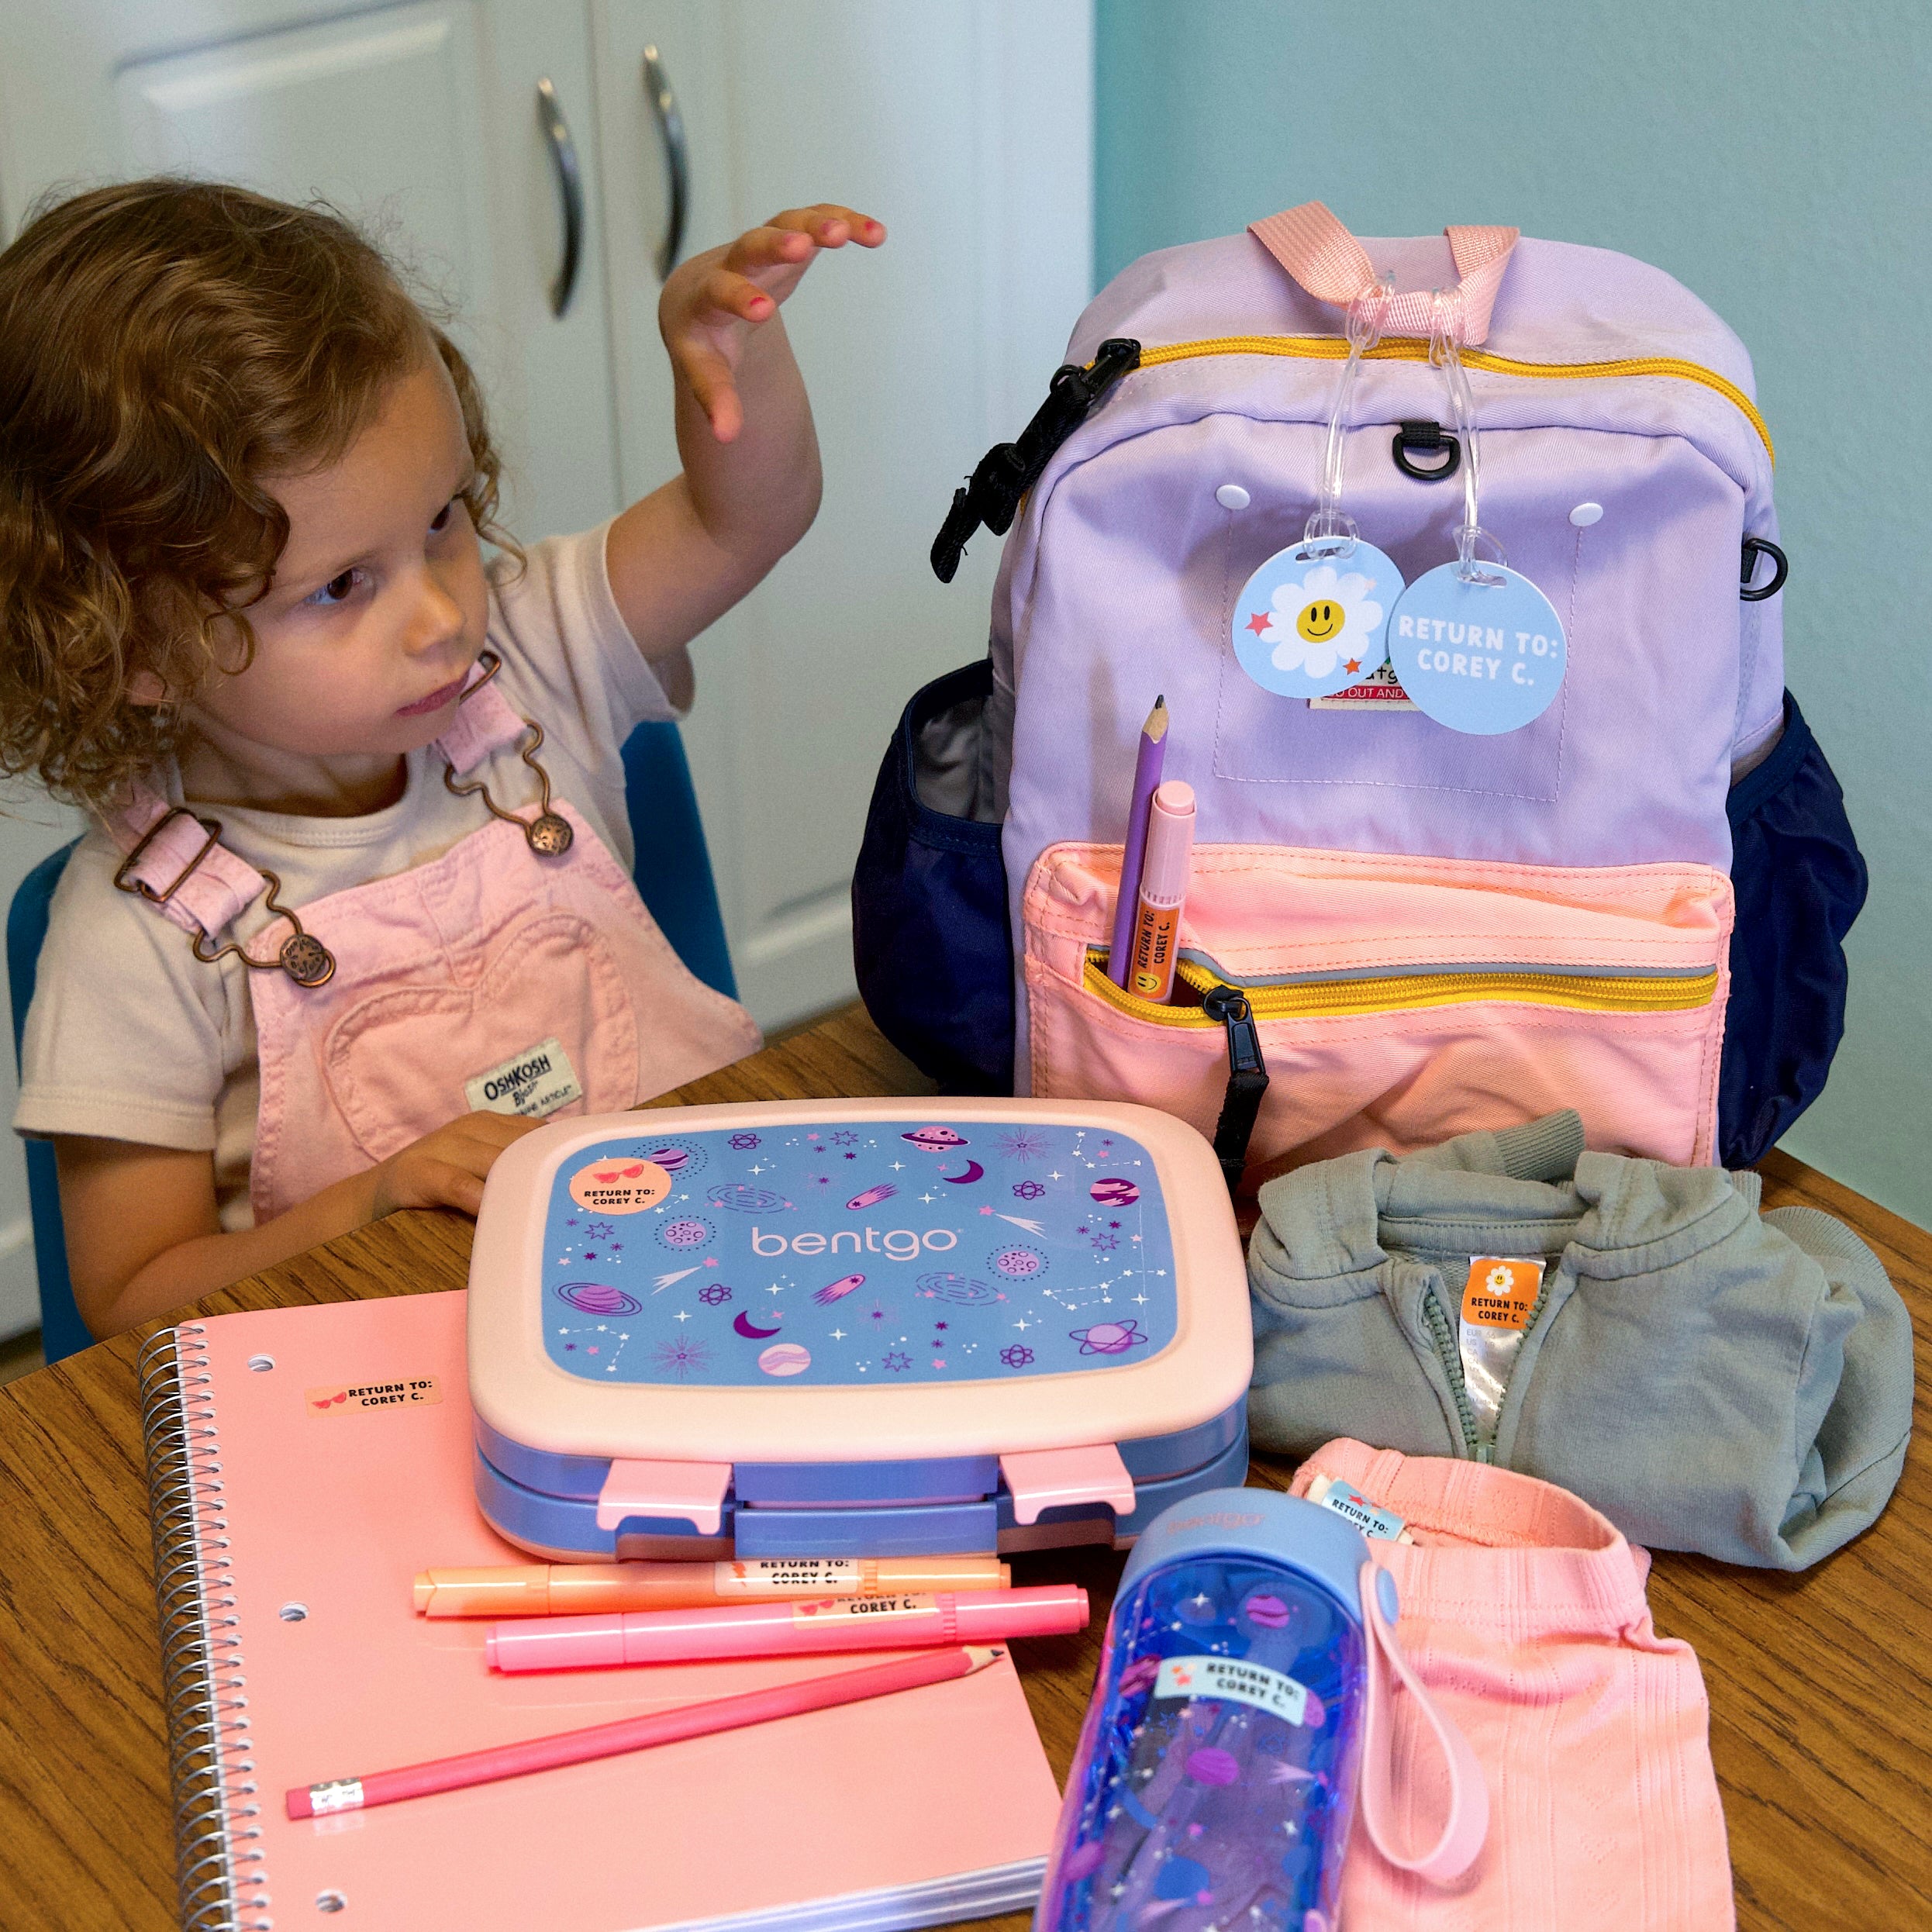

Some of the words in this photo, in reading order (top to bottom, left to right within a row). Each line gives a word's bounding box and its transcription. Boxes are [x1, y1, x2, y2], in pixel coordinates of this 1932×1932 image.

[1399, 615, 1504, 650] RETURN
[1516, 631, 1558, 658] TO:
[1417, 649, 1502, 681] COREY
[1512, 663, 1535, 685] C.
[1348, 687, 1375, 698] OUT
[1376, 688, 1404, 699] AND
[1158, 921, 1170, 931] C.
[1137, 929, 1152, 968] RETURN
[1154, 934, 1168, 964] COREY
[484, 1054, 551, 1100] OSHKOSH
[751, 1226, 957, 1261] bentgo
[1471, 1297, 1510, 1309] RETURN
[1513, 1301, 1528, 1312] TO:
[1478, 1310, 1509, 1322] COREY
[1511, 1314, 1520, 1323] C.
[348, 1383, 404, 1397] RETURN
[409, 1381, 433, 1390] TO:
[361, 1394, 405, 1406] COREY
[1332, 1499, 1371, 1523] RETURN
[1373, 1520, 1389, 1534] TO:
[772, 1571, 818, 1584] COREY
[850, 1600, 897, 1613] COREY
[903, 1599, 916, 1609] C.
[1206, 1662, 1270, 1685] RETURN
[1216, 1677, 1266, 1697] COREY
